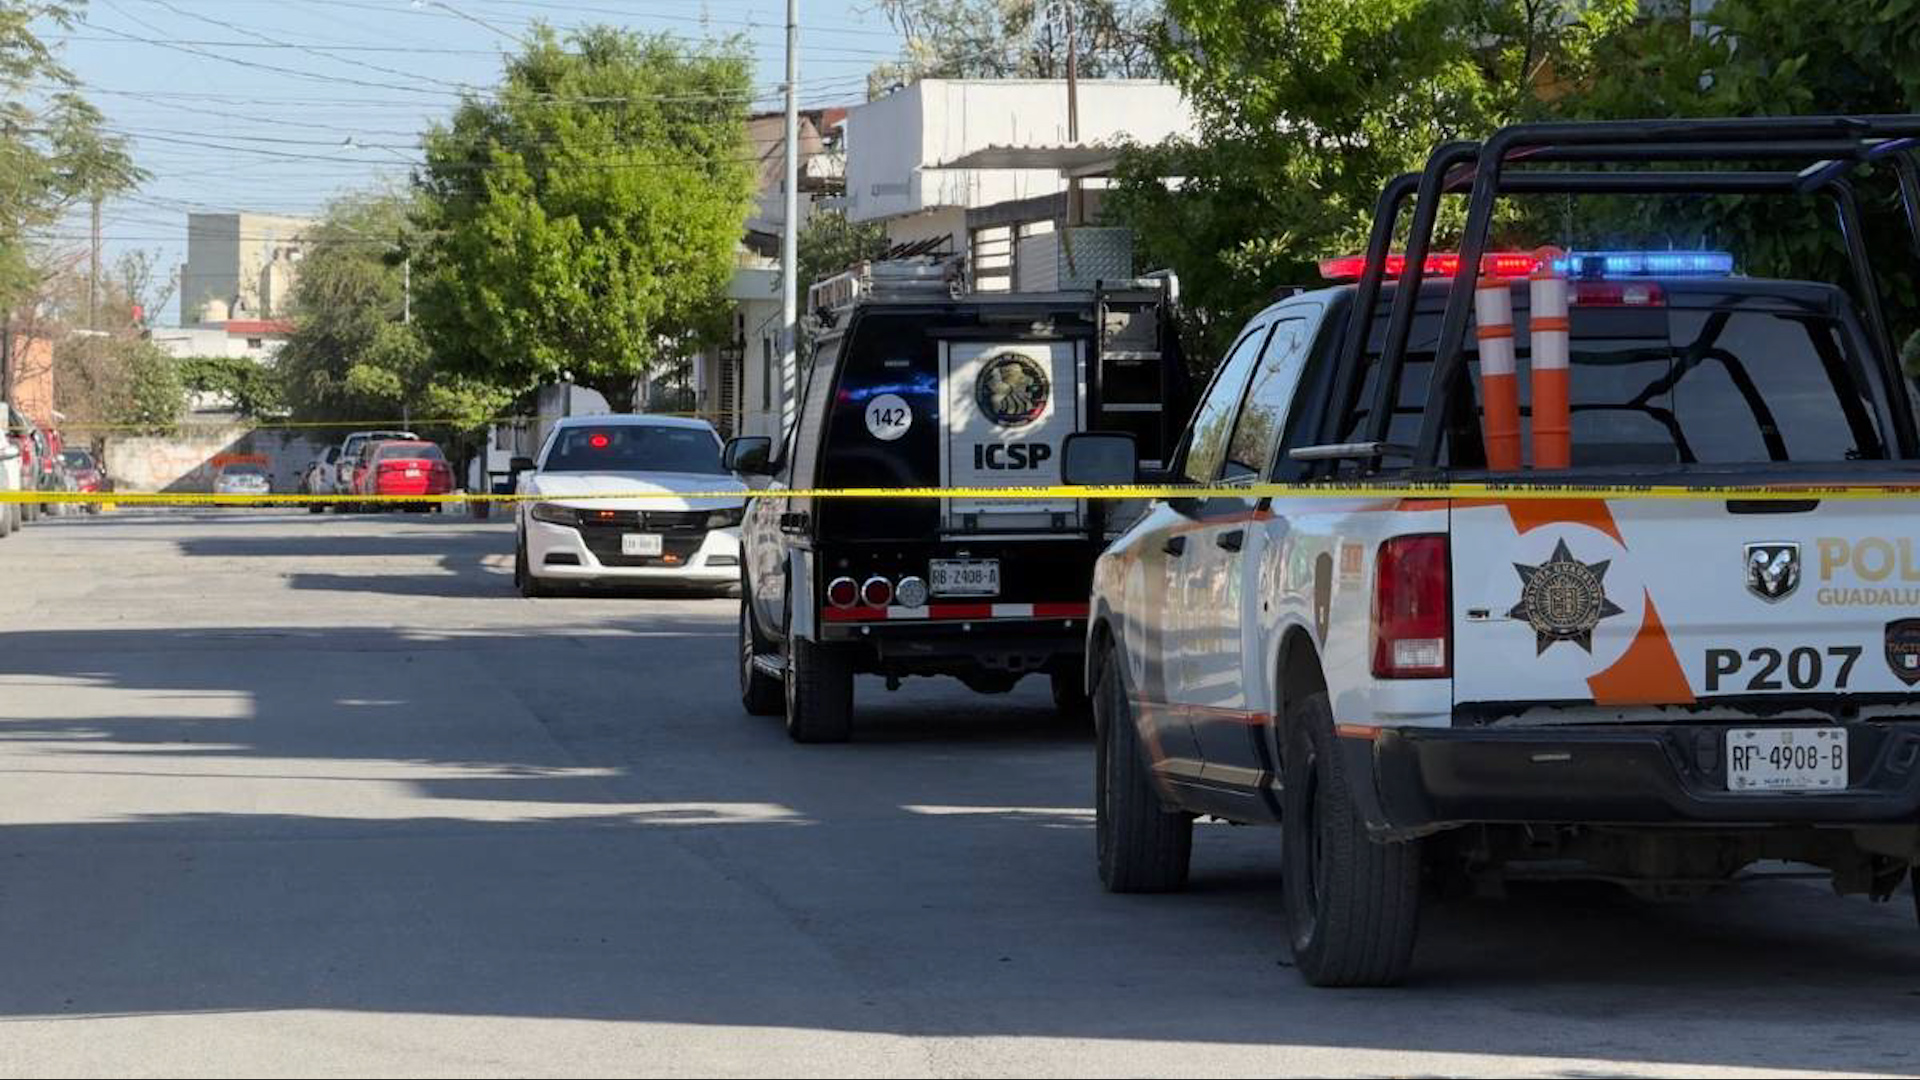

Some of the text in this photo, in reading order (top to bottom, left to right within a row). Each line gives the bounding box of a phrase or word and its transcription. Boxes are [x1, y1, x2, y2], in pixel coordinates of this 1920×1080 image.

[873, 408, 906, 426] 142
[974, 444, 1052, 470] ICSP
[1704, 645, 1863, 691] P207
[1732, 745, 1843, 771] RF-4908-B
